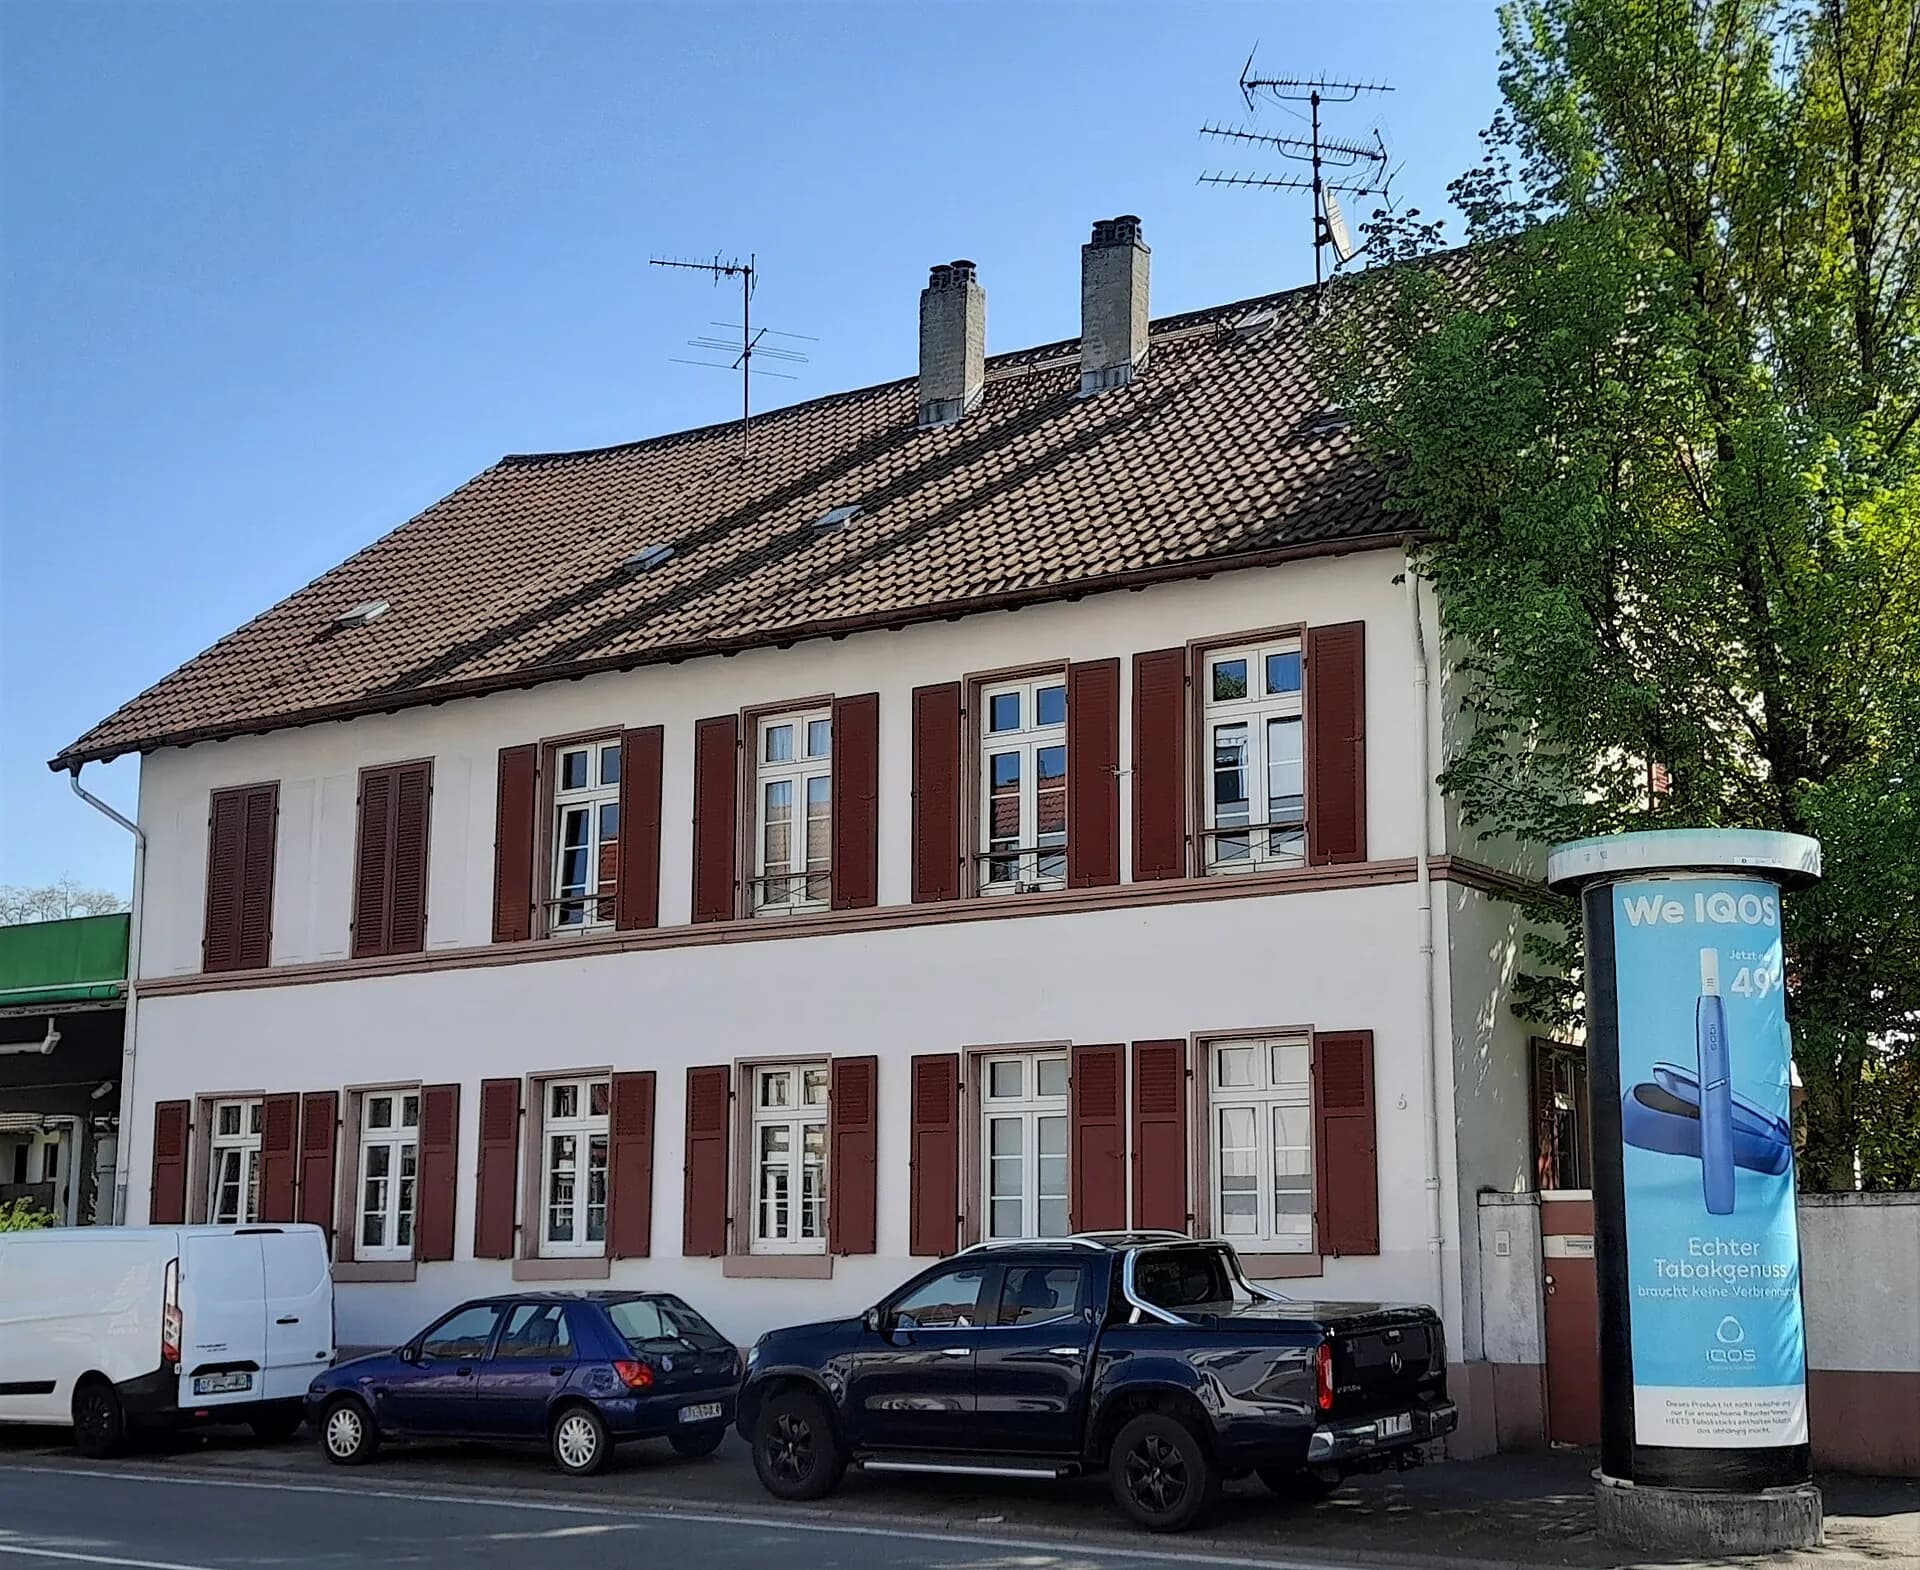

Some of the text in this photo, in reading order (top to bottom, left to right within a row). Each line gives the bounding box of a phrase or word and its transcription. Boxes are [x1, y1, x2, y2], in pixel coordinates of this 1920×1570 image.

[1623, 892, 1776, 926] We IQOS
[1729, 949, 1757, 961] Jetzt
[1688, 1237, 1761, 1257] Echter
[1653, 1258, 1788, 1285] Tabakgenuss
[1638, 1284, 1688, 1297] braucht
[1692, 1284, 1728, 1297] keine
[1706, 1350, 1756, 1363] IQOS
